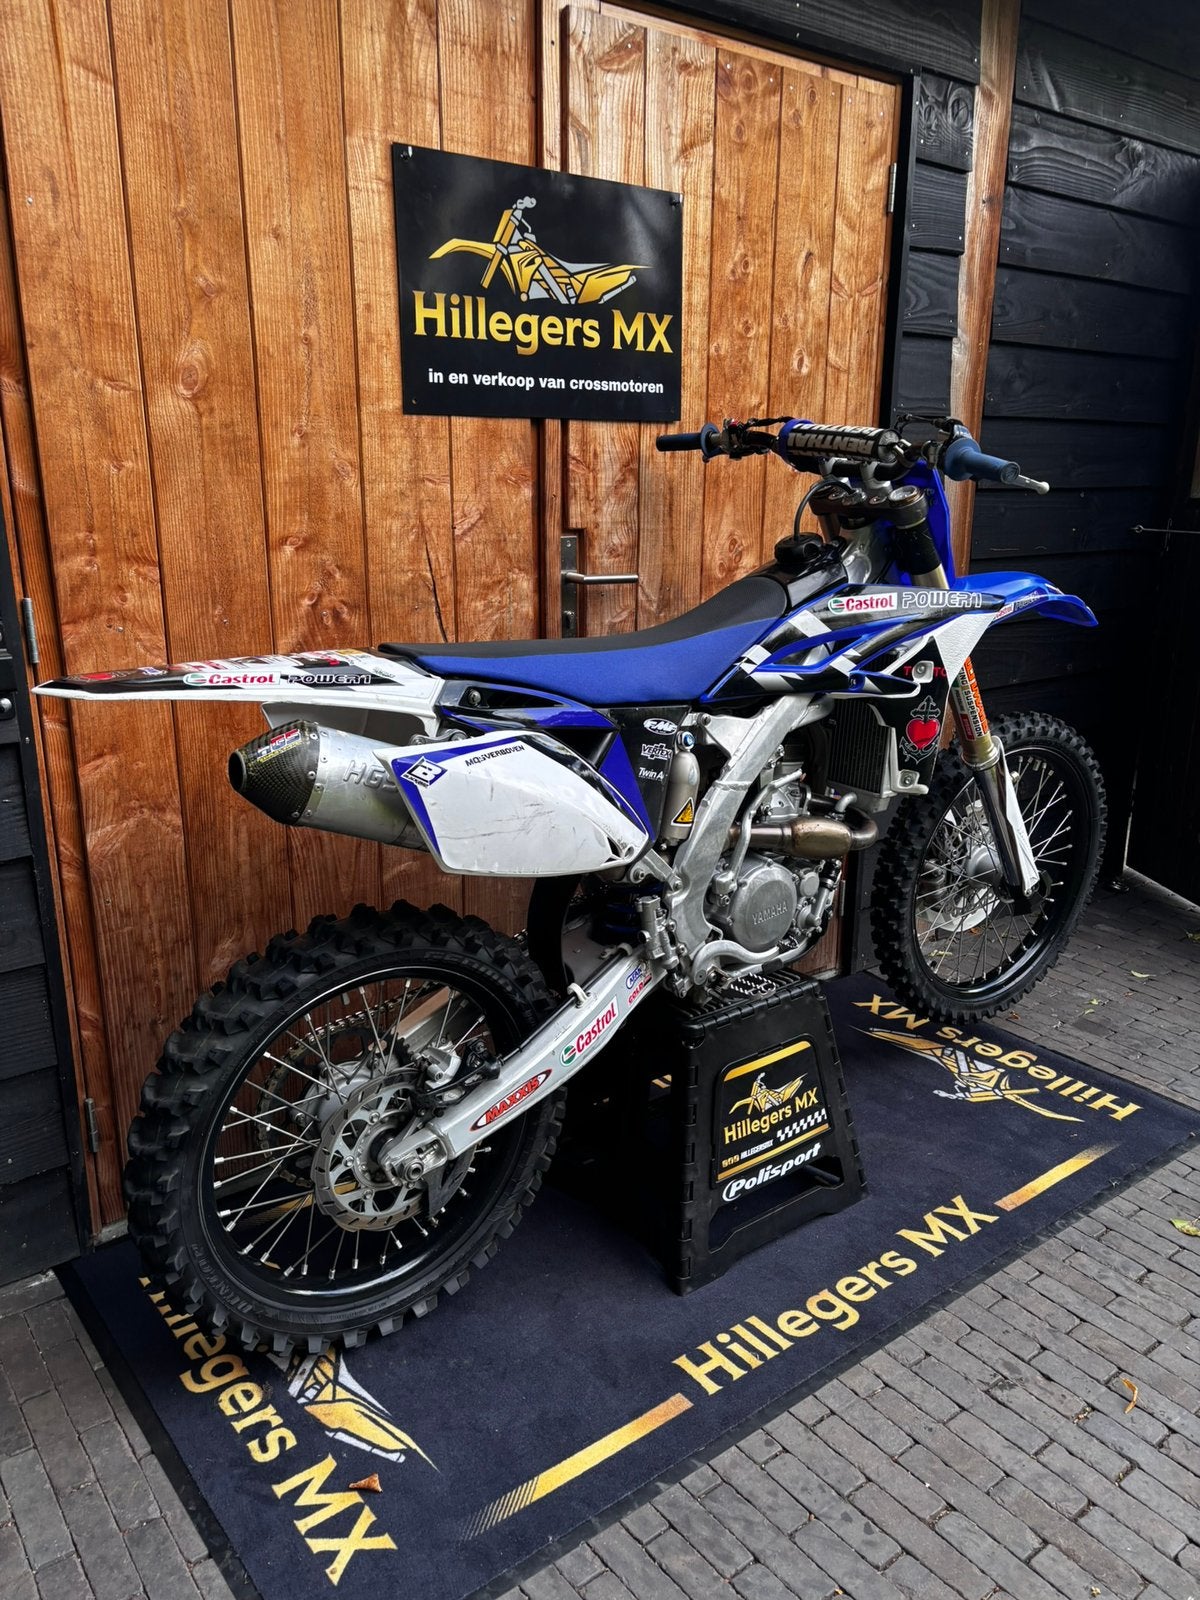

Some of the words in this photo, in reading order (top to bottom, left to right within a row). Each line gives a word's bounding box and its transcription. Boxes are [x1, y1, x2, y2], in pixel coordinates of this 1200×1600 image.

[412, 290, 601, 356] Hillegers
[611, 309, 674, 354] MX
[428, 368, 443, 384] in
[448, 373, 468, 386] en
[473, 372, 535, 391] verkoop
[539, 376, 566, 390] van
[569, 376, 664, 394] crossmotoren
[845, 593, 894, 612] Castrol
[208, 673, 275, 685] Castrol
[287, 673, 371, 685] POWER1
[638, 766, 657, 779] Twin
[752, 901, 788, 925] YAMAHA
[575, 1002, 618, 1054] Castrol
[936, 1026, 1143, 1121] Hillegers
[484, 1076, 540, 1125] MAXXIS
[723, 1104, 792, 1145] Hillegers
[795, 1087, 819, 1114] MX
[722, 1142, 822, 1202] Polisport
[672, 1250, 918, 1396] Hillegers
[896, 1194, 1000, 1258] MX
[271, 1452, 398, 1586] MX
